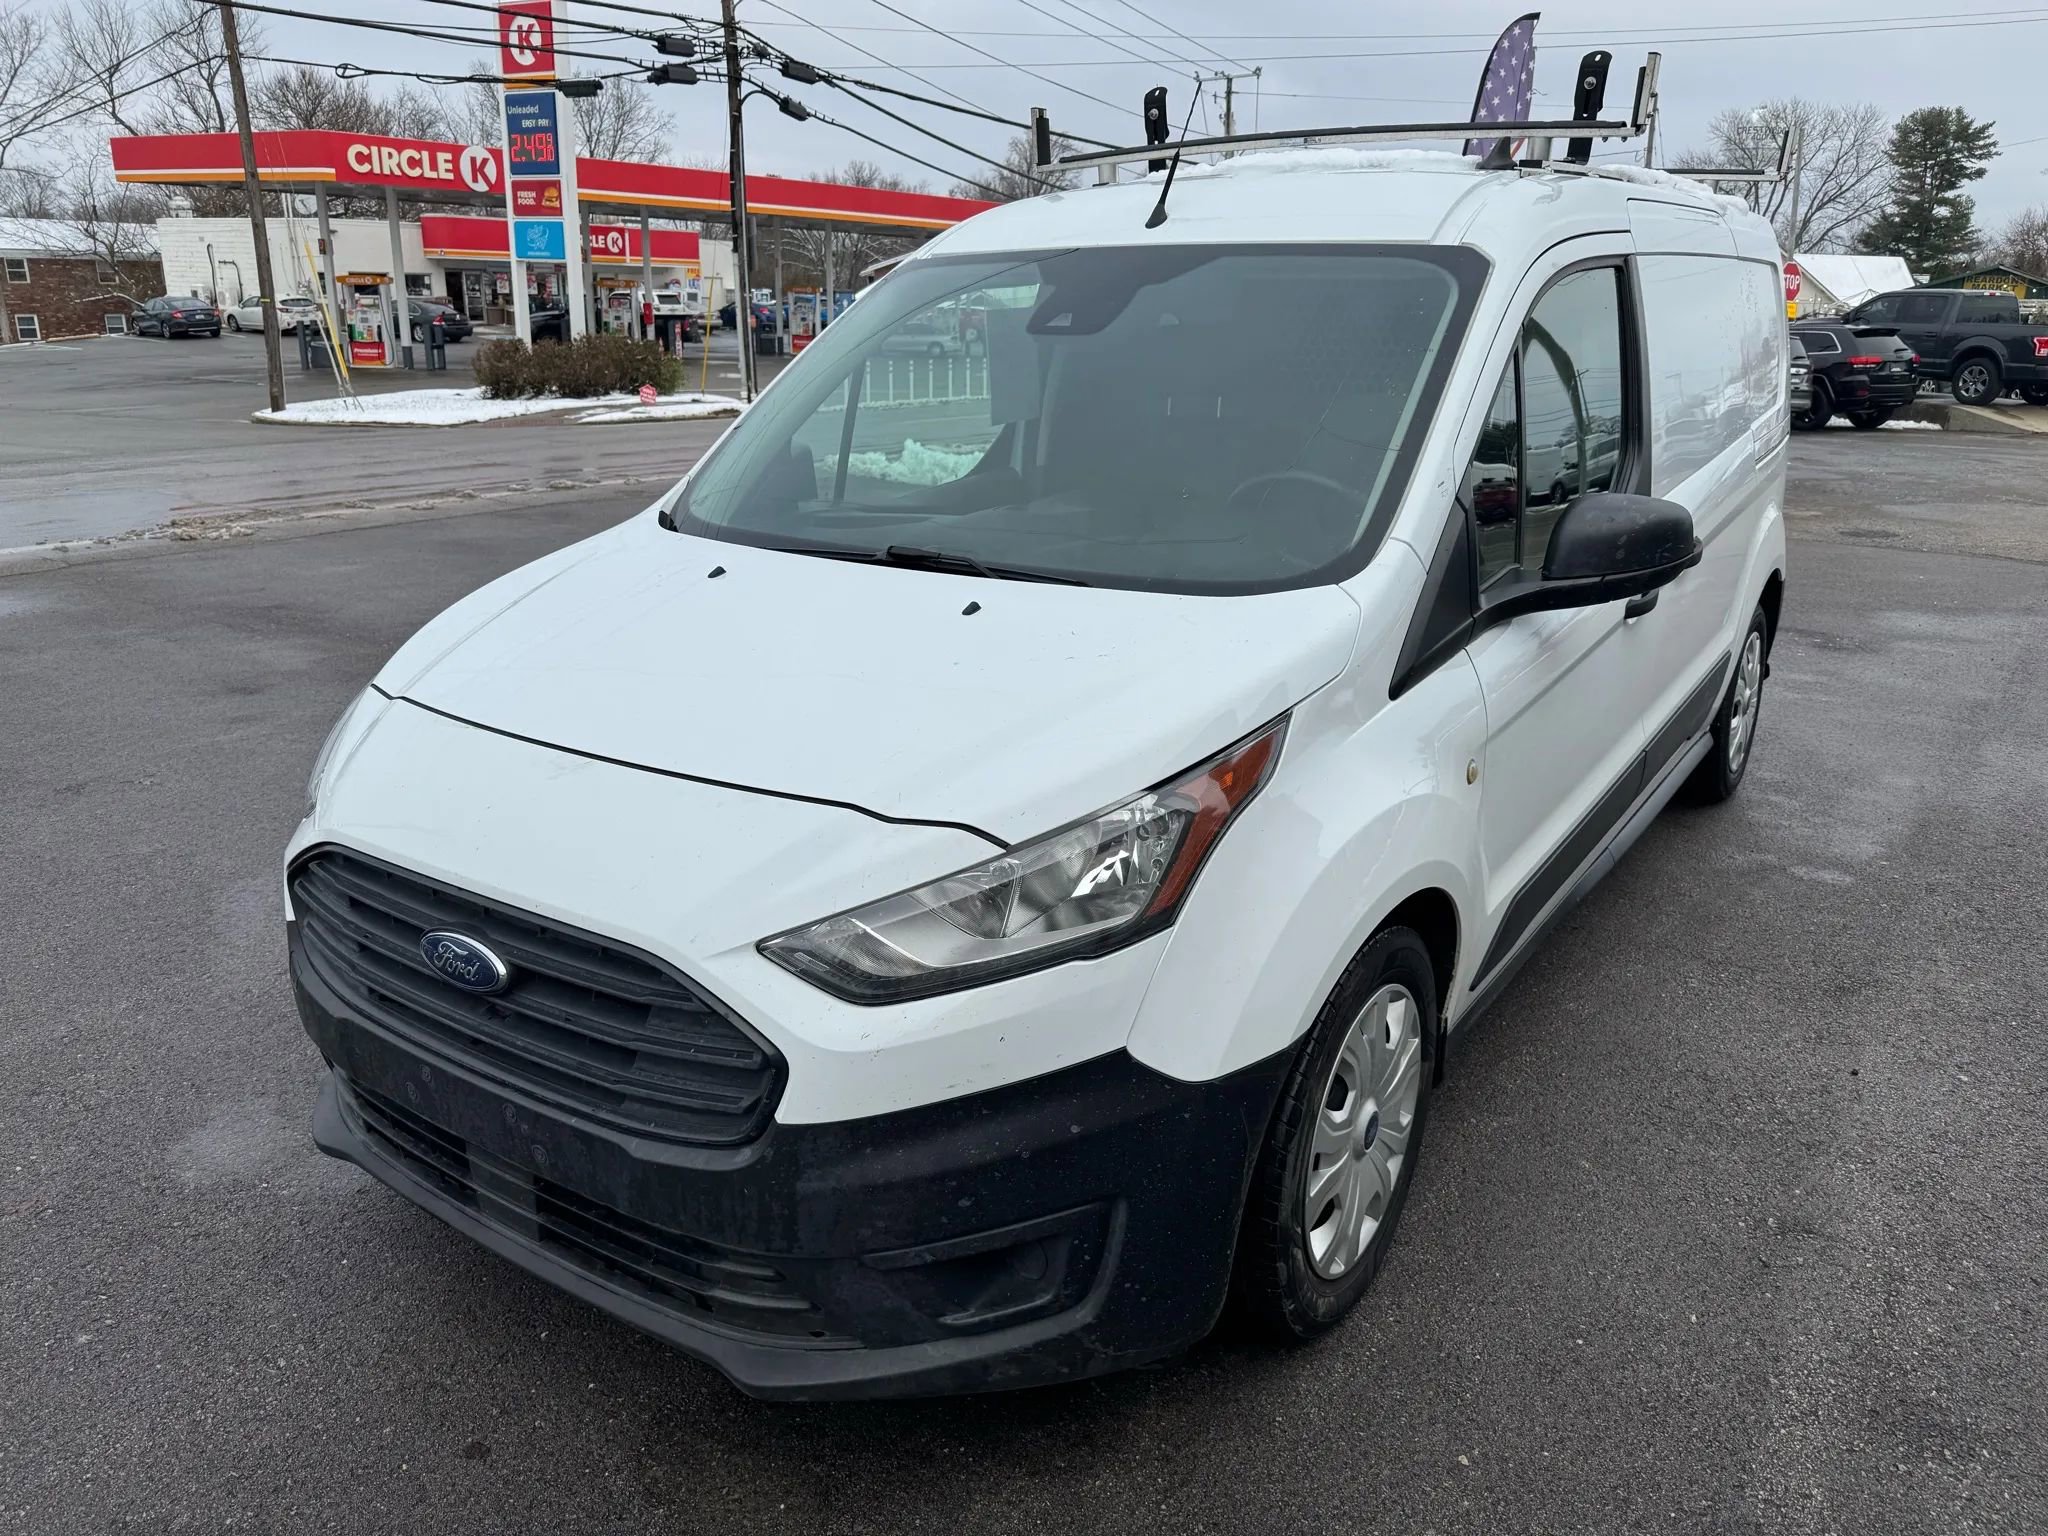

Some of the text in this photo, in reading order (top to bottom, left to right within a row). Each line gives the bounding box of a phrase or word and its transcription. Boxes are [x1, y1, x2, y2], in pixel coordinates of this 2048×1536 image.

[515, 21, 539, 60] K
[507, 104, 539, 114] Unleaded
[522, 118, 549, 128] EASY PAY
[347, 144, 495, 190] CIRCLE K
[1783, 274, 1800, 290] TOP
[434, 941, 480, 980] Ford
